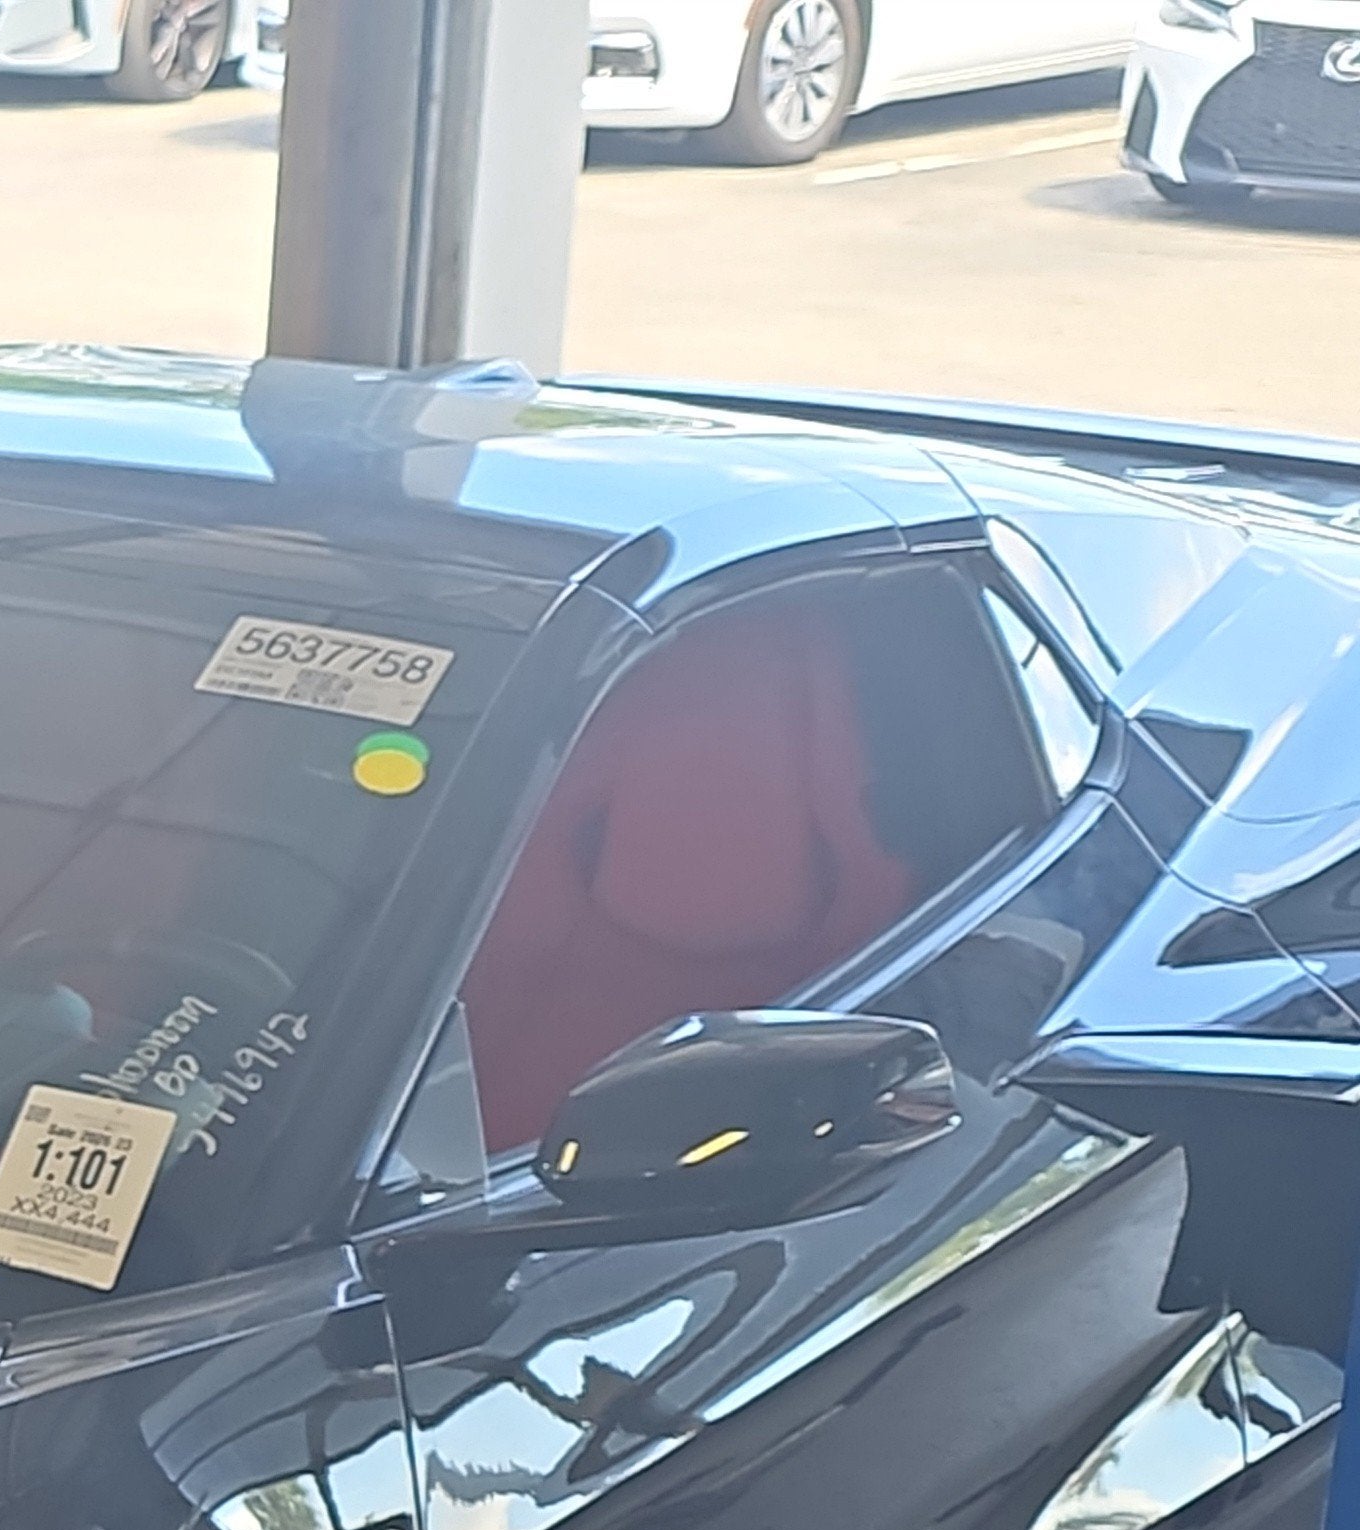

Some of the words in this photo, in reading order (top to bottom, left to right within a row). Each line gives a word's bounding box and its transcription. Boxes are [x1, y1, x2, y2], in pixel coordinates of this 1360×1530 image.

[235, 626, 434, 685] 5637758
[32, 1139, 127, 1196] 1:101
[37, 1183, 99, 1212] 2023
